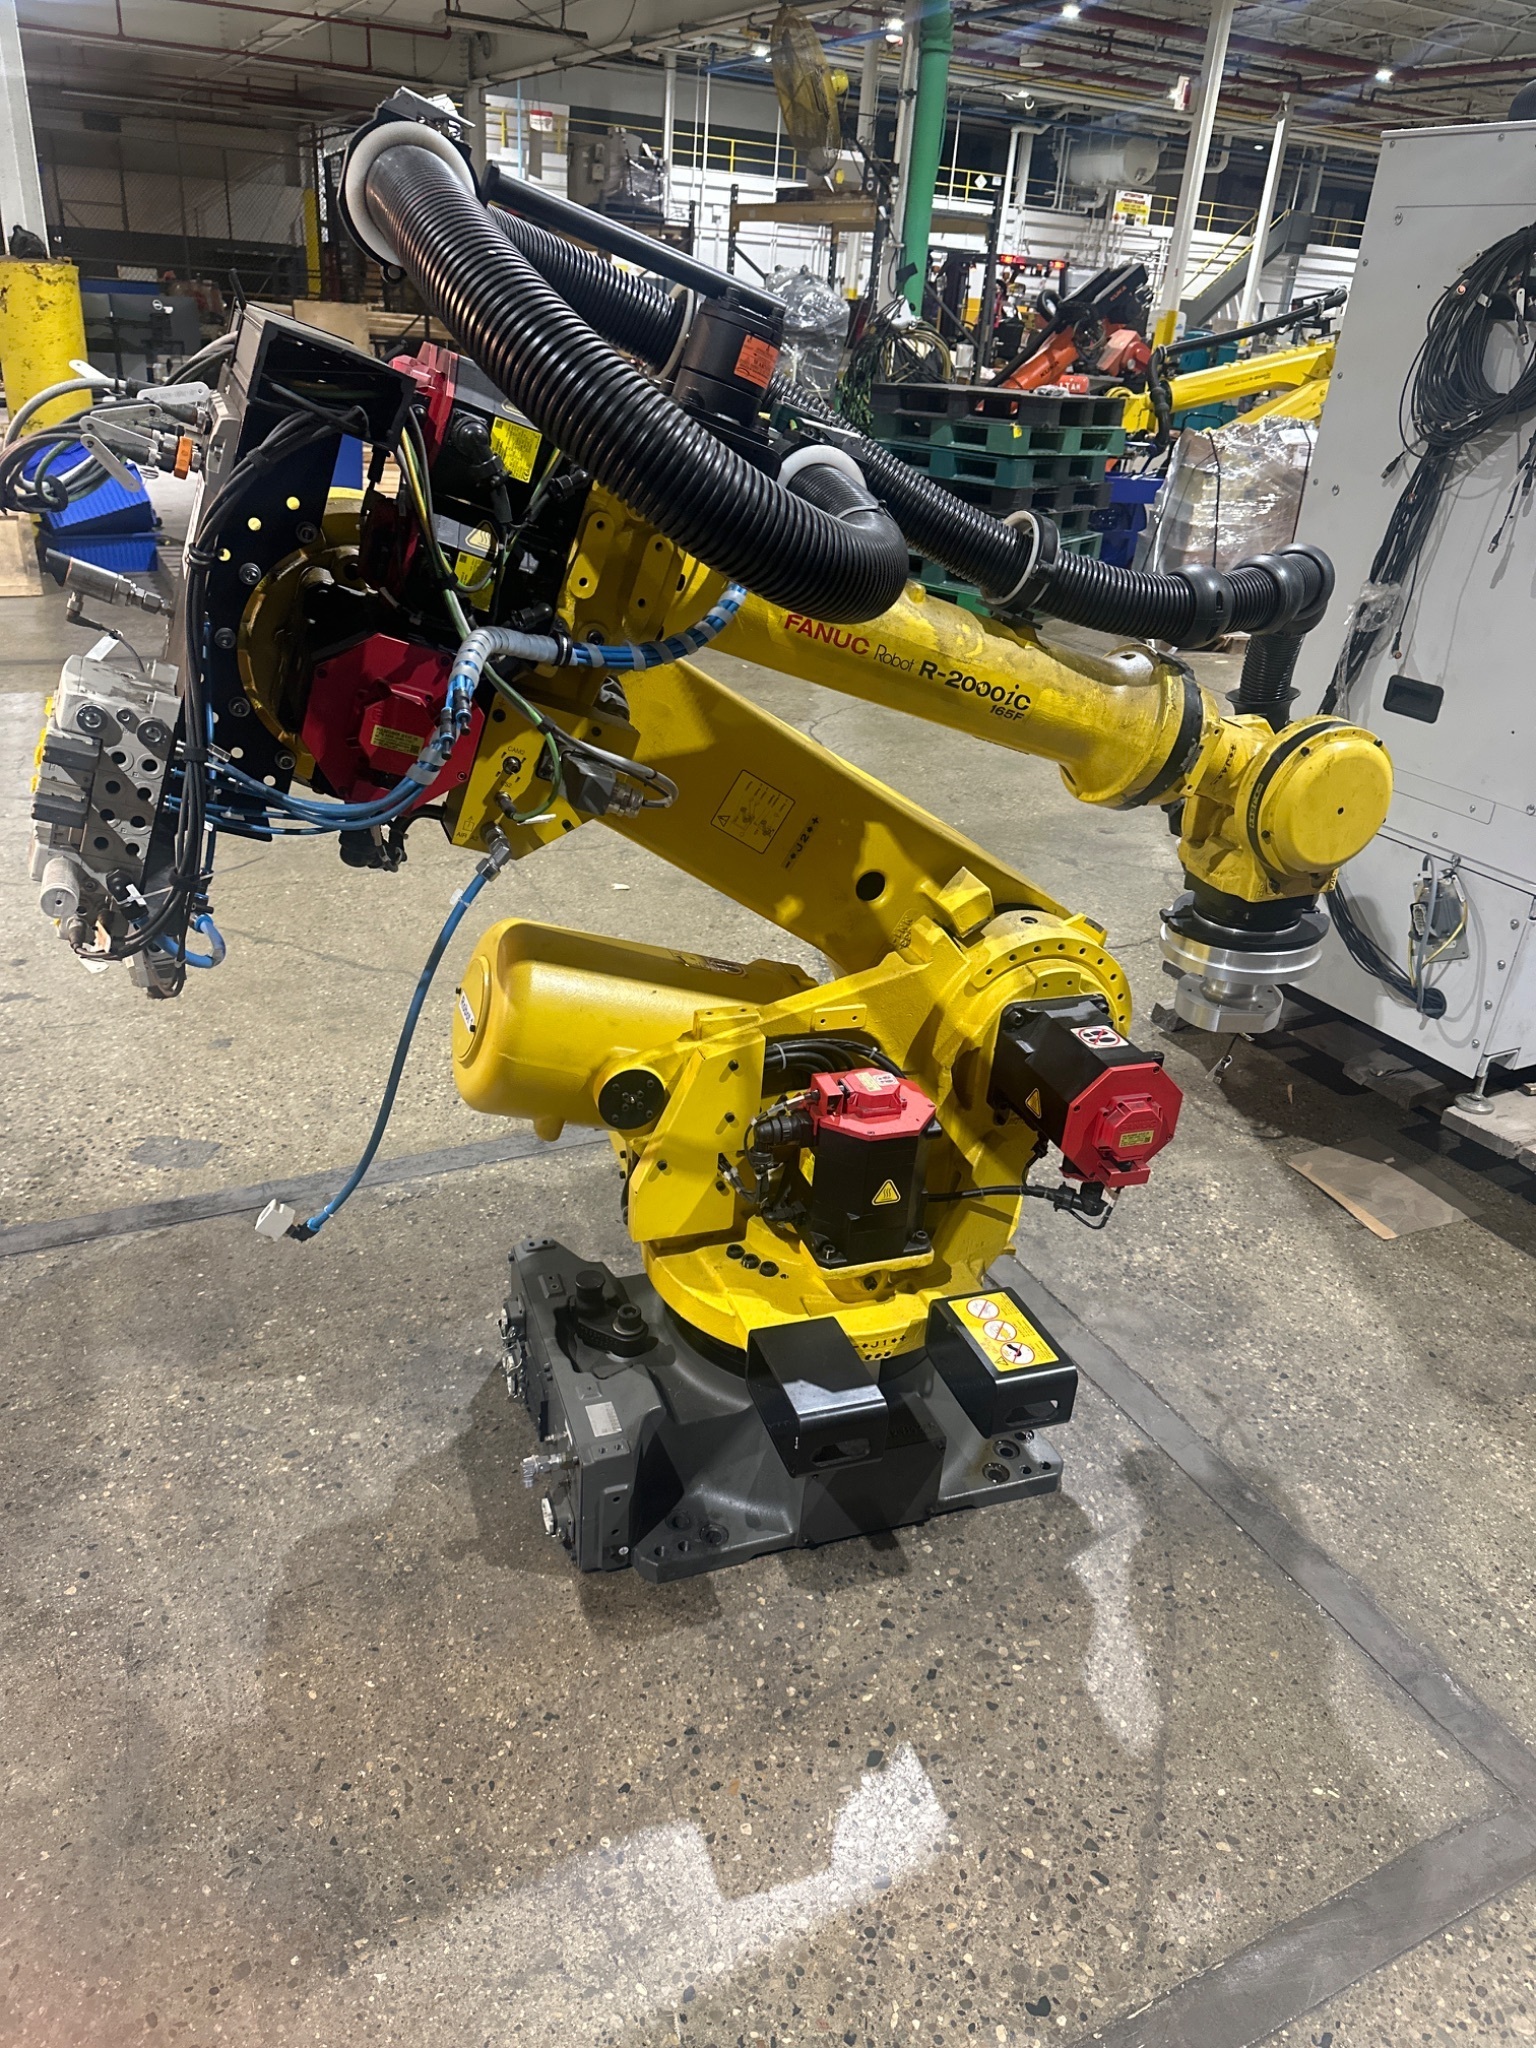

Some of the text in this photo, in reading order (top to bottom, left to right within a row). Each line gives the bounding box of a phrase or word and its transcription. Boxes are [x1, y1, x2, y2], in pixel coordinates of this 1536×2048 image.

[1040, 361, 1059, 378] KUKA
[784, 613, 1031, 713] FANUC Robot R-2000iC
[989, 704, 1025, 722] 165F
[507, 745, 526, 756] CAM2
[456, 831, 467, 839] AIR
